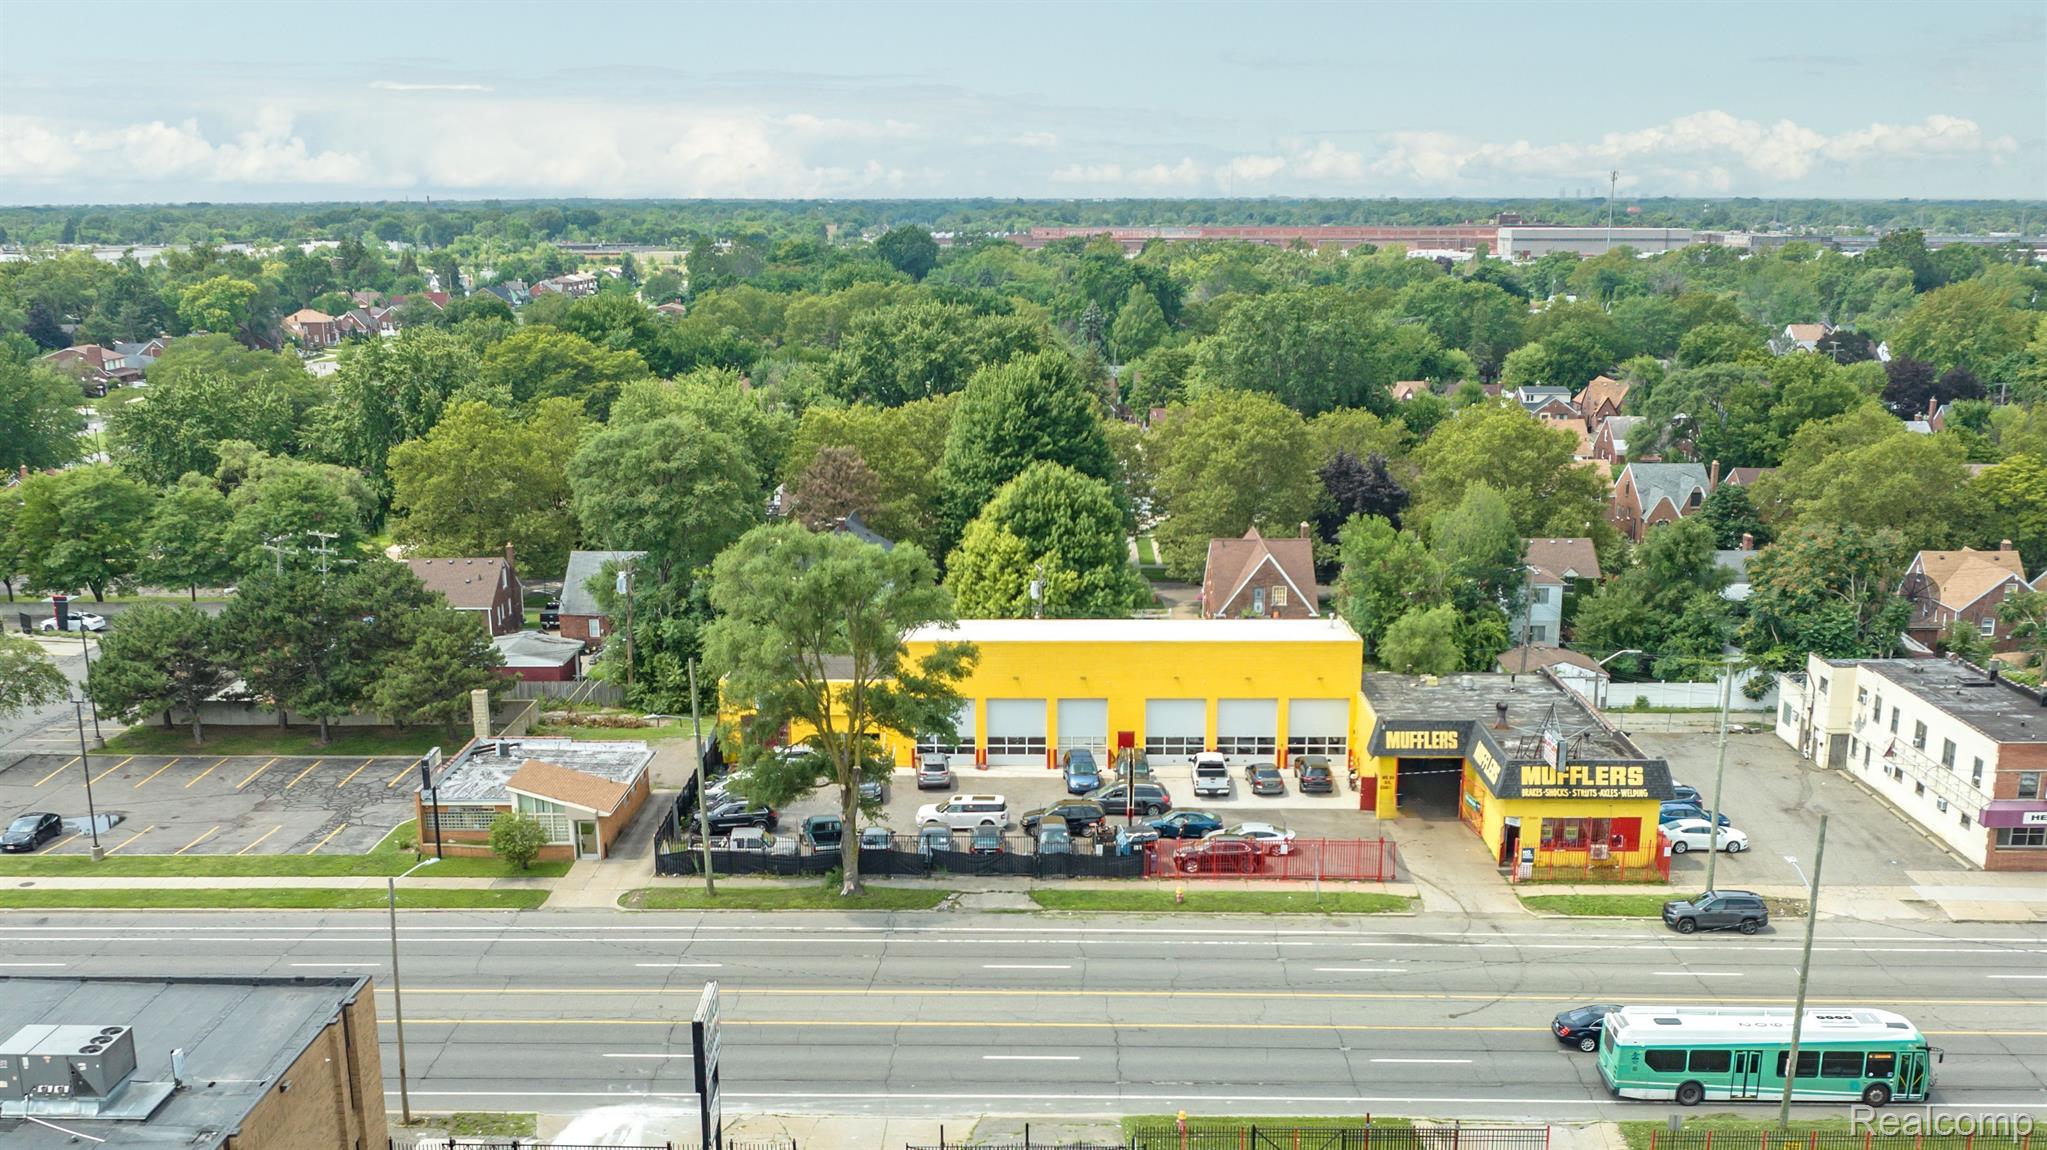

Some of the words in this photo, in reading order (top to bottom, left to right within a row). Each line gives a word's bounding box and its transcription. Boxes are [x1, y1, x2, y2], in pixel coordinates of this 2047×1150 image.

[1385, 730, 1459, 750] MUFFLERS
[1472, 740, 1502, 785] MUFFLERS
[1520, 765, 1645, 786] MUFFLERS
[1521, 788, 1543, 798] BRAKES
[1544, 788, 1569, 798] SHOCKS
[1572, 788, 1597, 798] STRUTS
[1599, 788, 1619, 798] AXLES
[1620, 788, 1649, 798] WELDING
